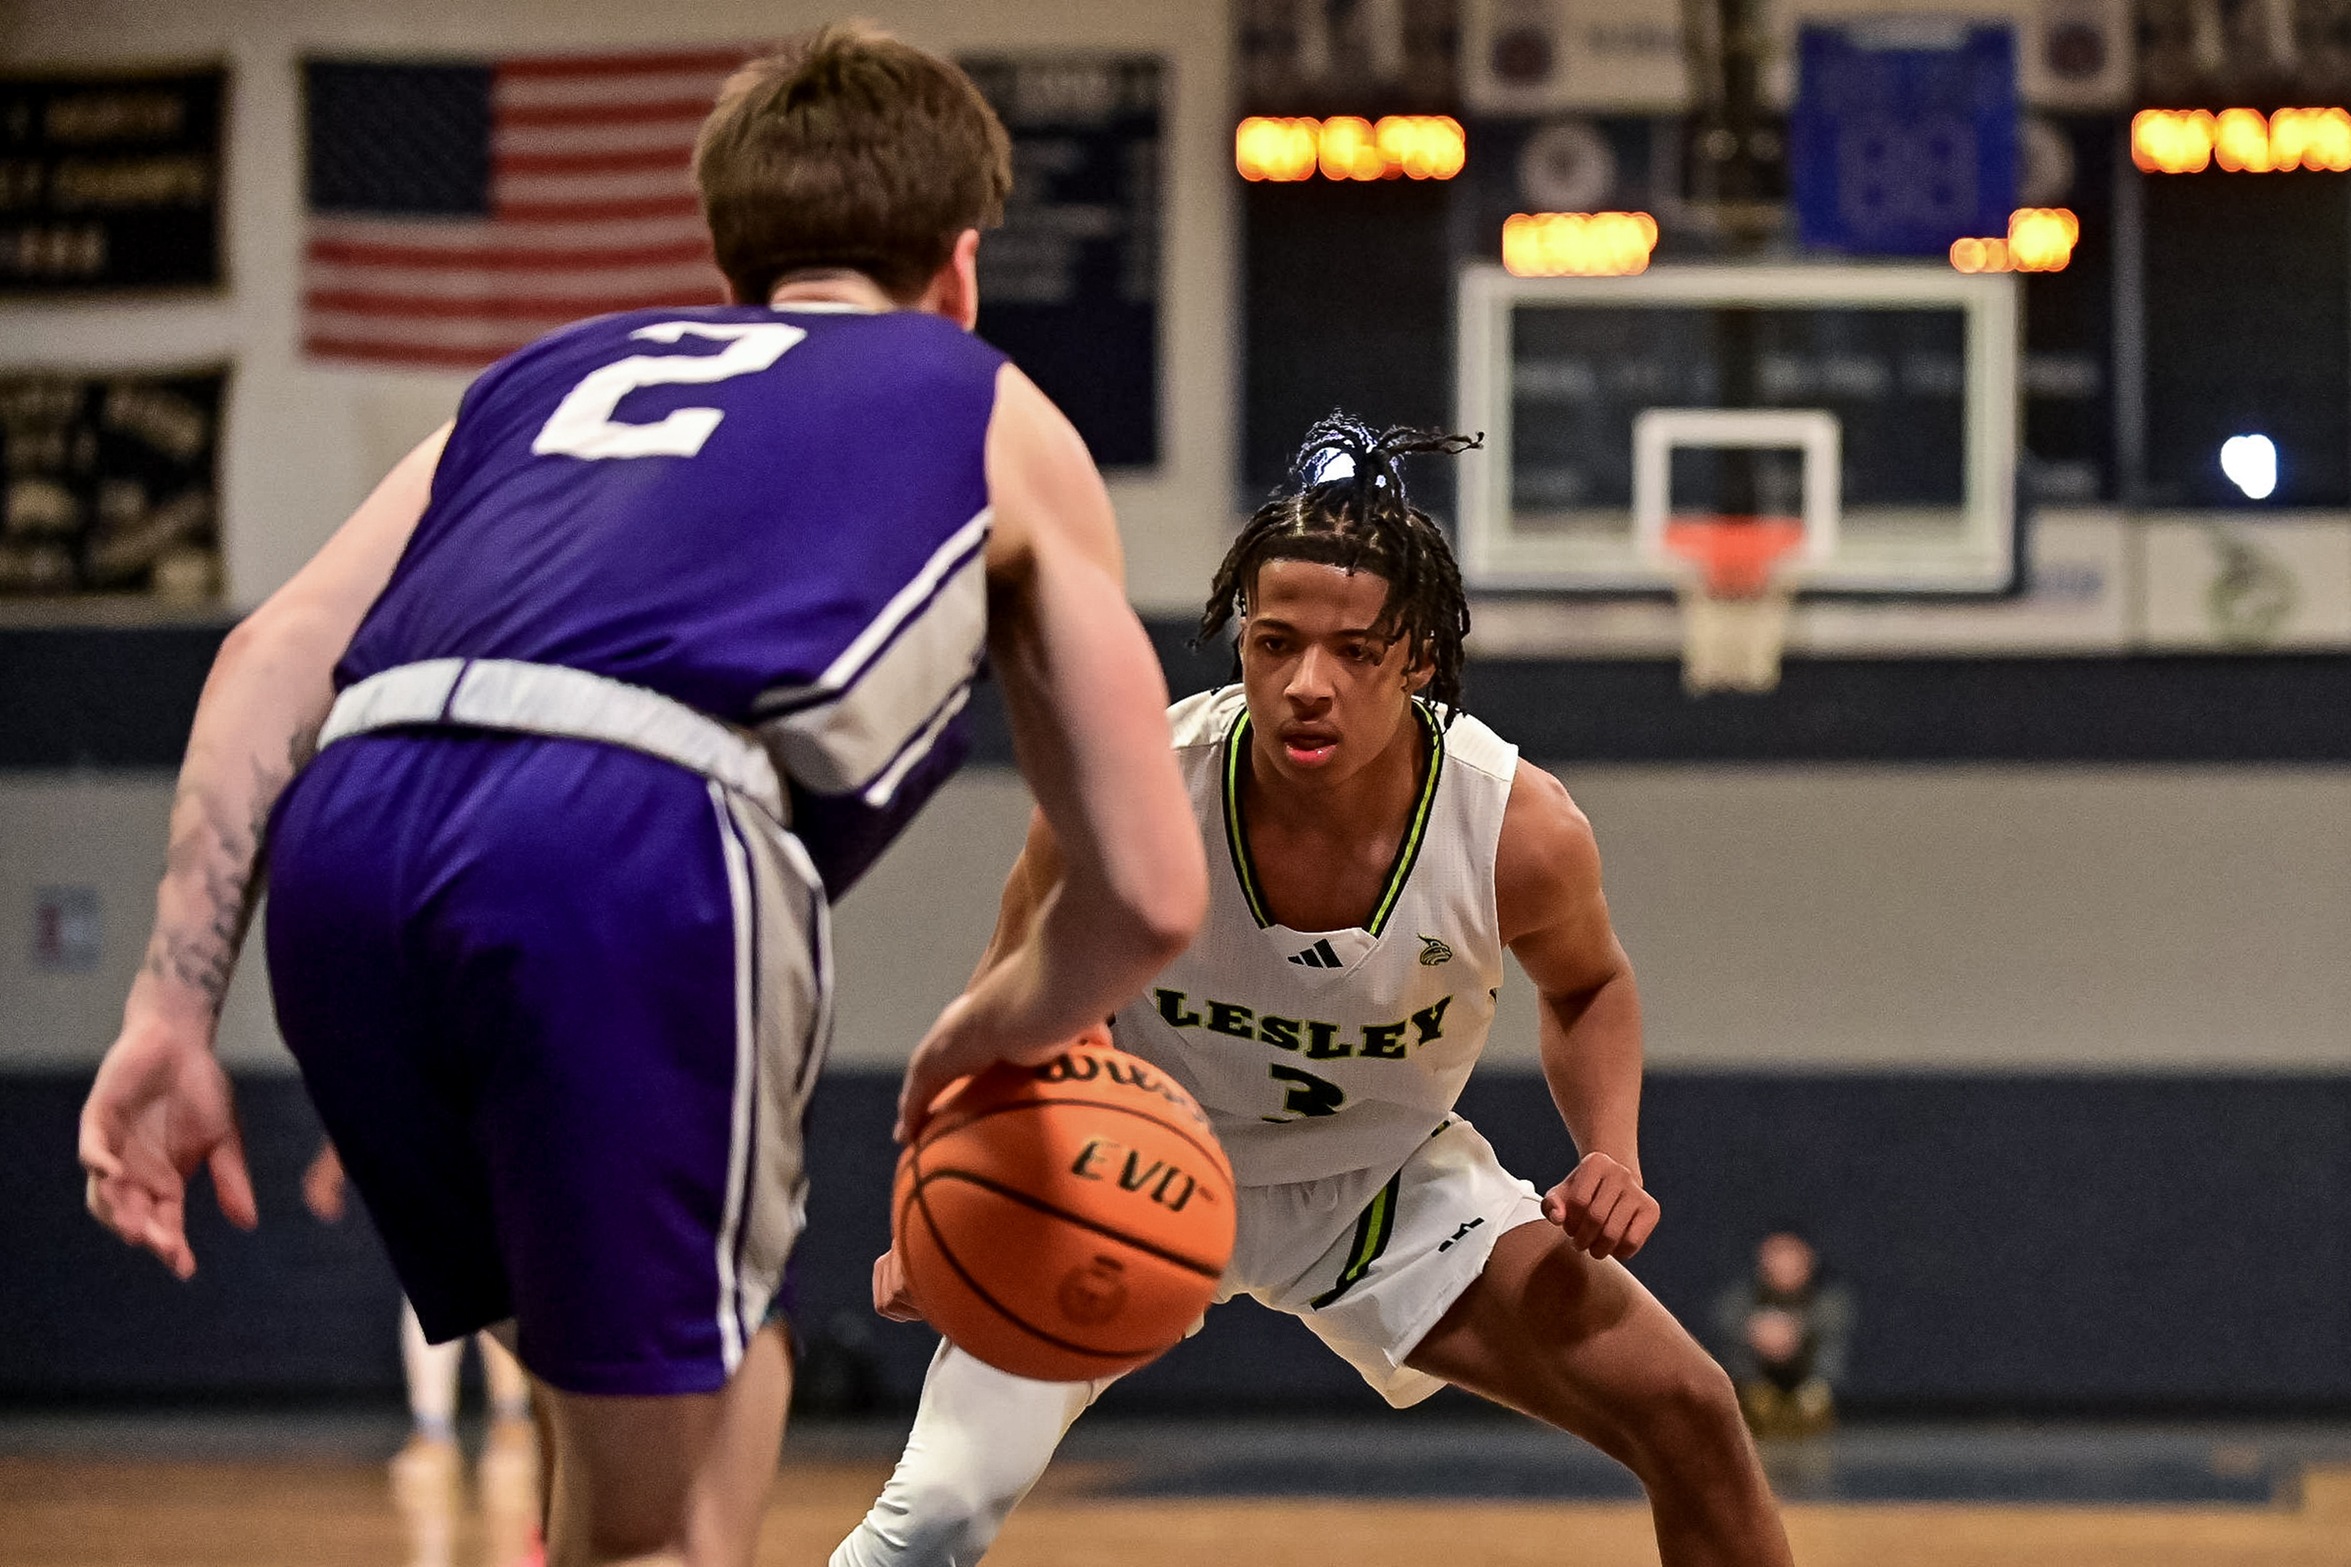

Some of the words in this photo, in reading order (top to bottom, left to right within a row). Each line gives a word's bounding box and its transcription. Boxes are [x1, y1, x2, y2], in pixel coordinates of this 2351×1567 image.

[531, 320, 808, 461] 2
[1153, 986, 1454, 1061] LESLEY
[1071, 1139, 1196, 1213] EVO
